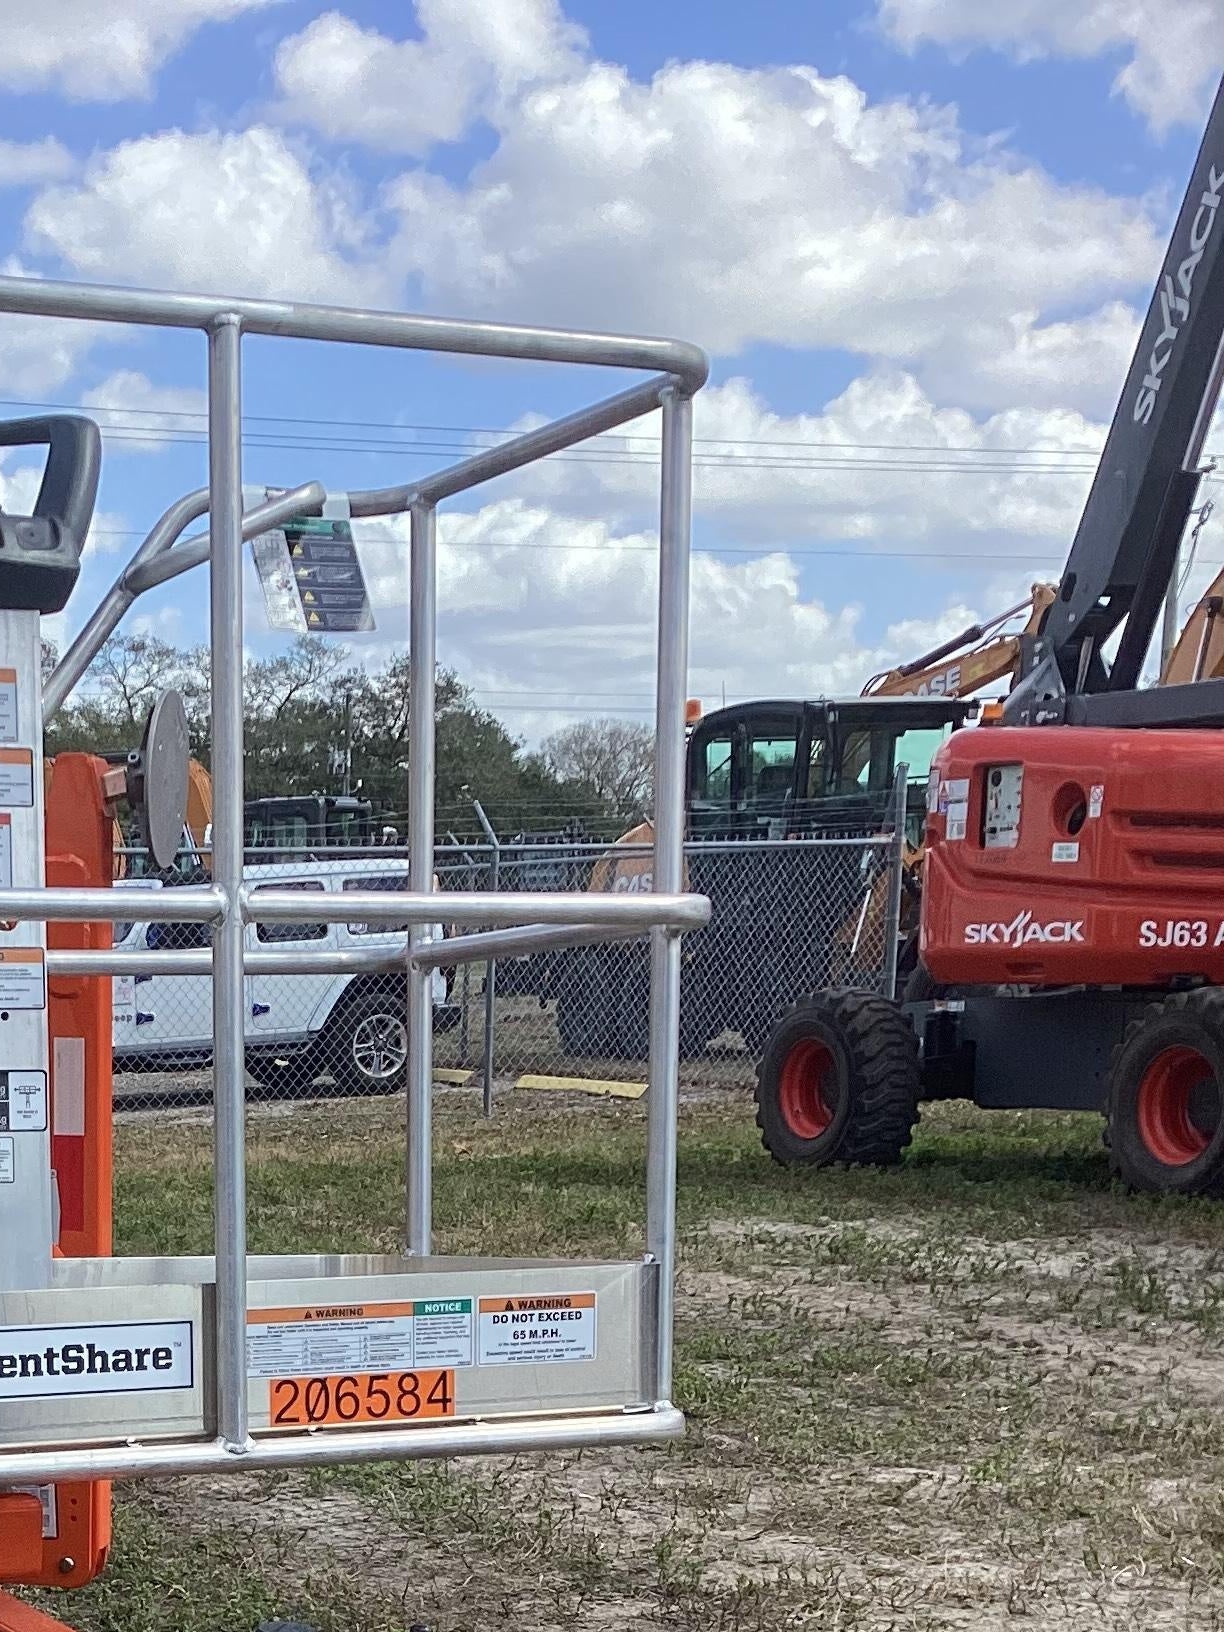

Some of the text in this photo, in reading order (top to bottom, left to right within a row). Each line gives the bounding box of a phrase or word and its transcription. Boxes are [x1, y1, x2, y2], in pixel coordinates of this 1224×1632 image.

[1134, 164, 1224, 425] SKYJACK
[903, 665, 961, 696] ASE
[614, 872, 653, 893] CAS
[964, 909, 1085, 948] SKYJACK
[1139, 920, 1207, 947] SJ63
[315, 1302, 462, 1319] WARNING NOTICE
[518, 1298, 572, 1310] WARNING
[492, 1310, 582, 1325] DO NOT EXCEED
[513, 1328, 562, 1340] 65 M.P.H.
[274, 1371, 452, 1424] 206584
